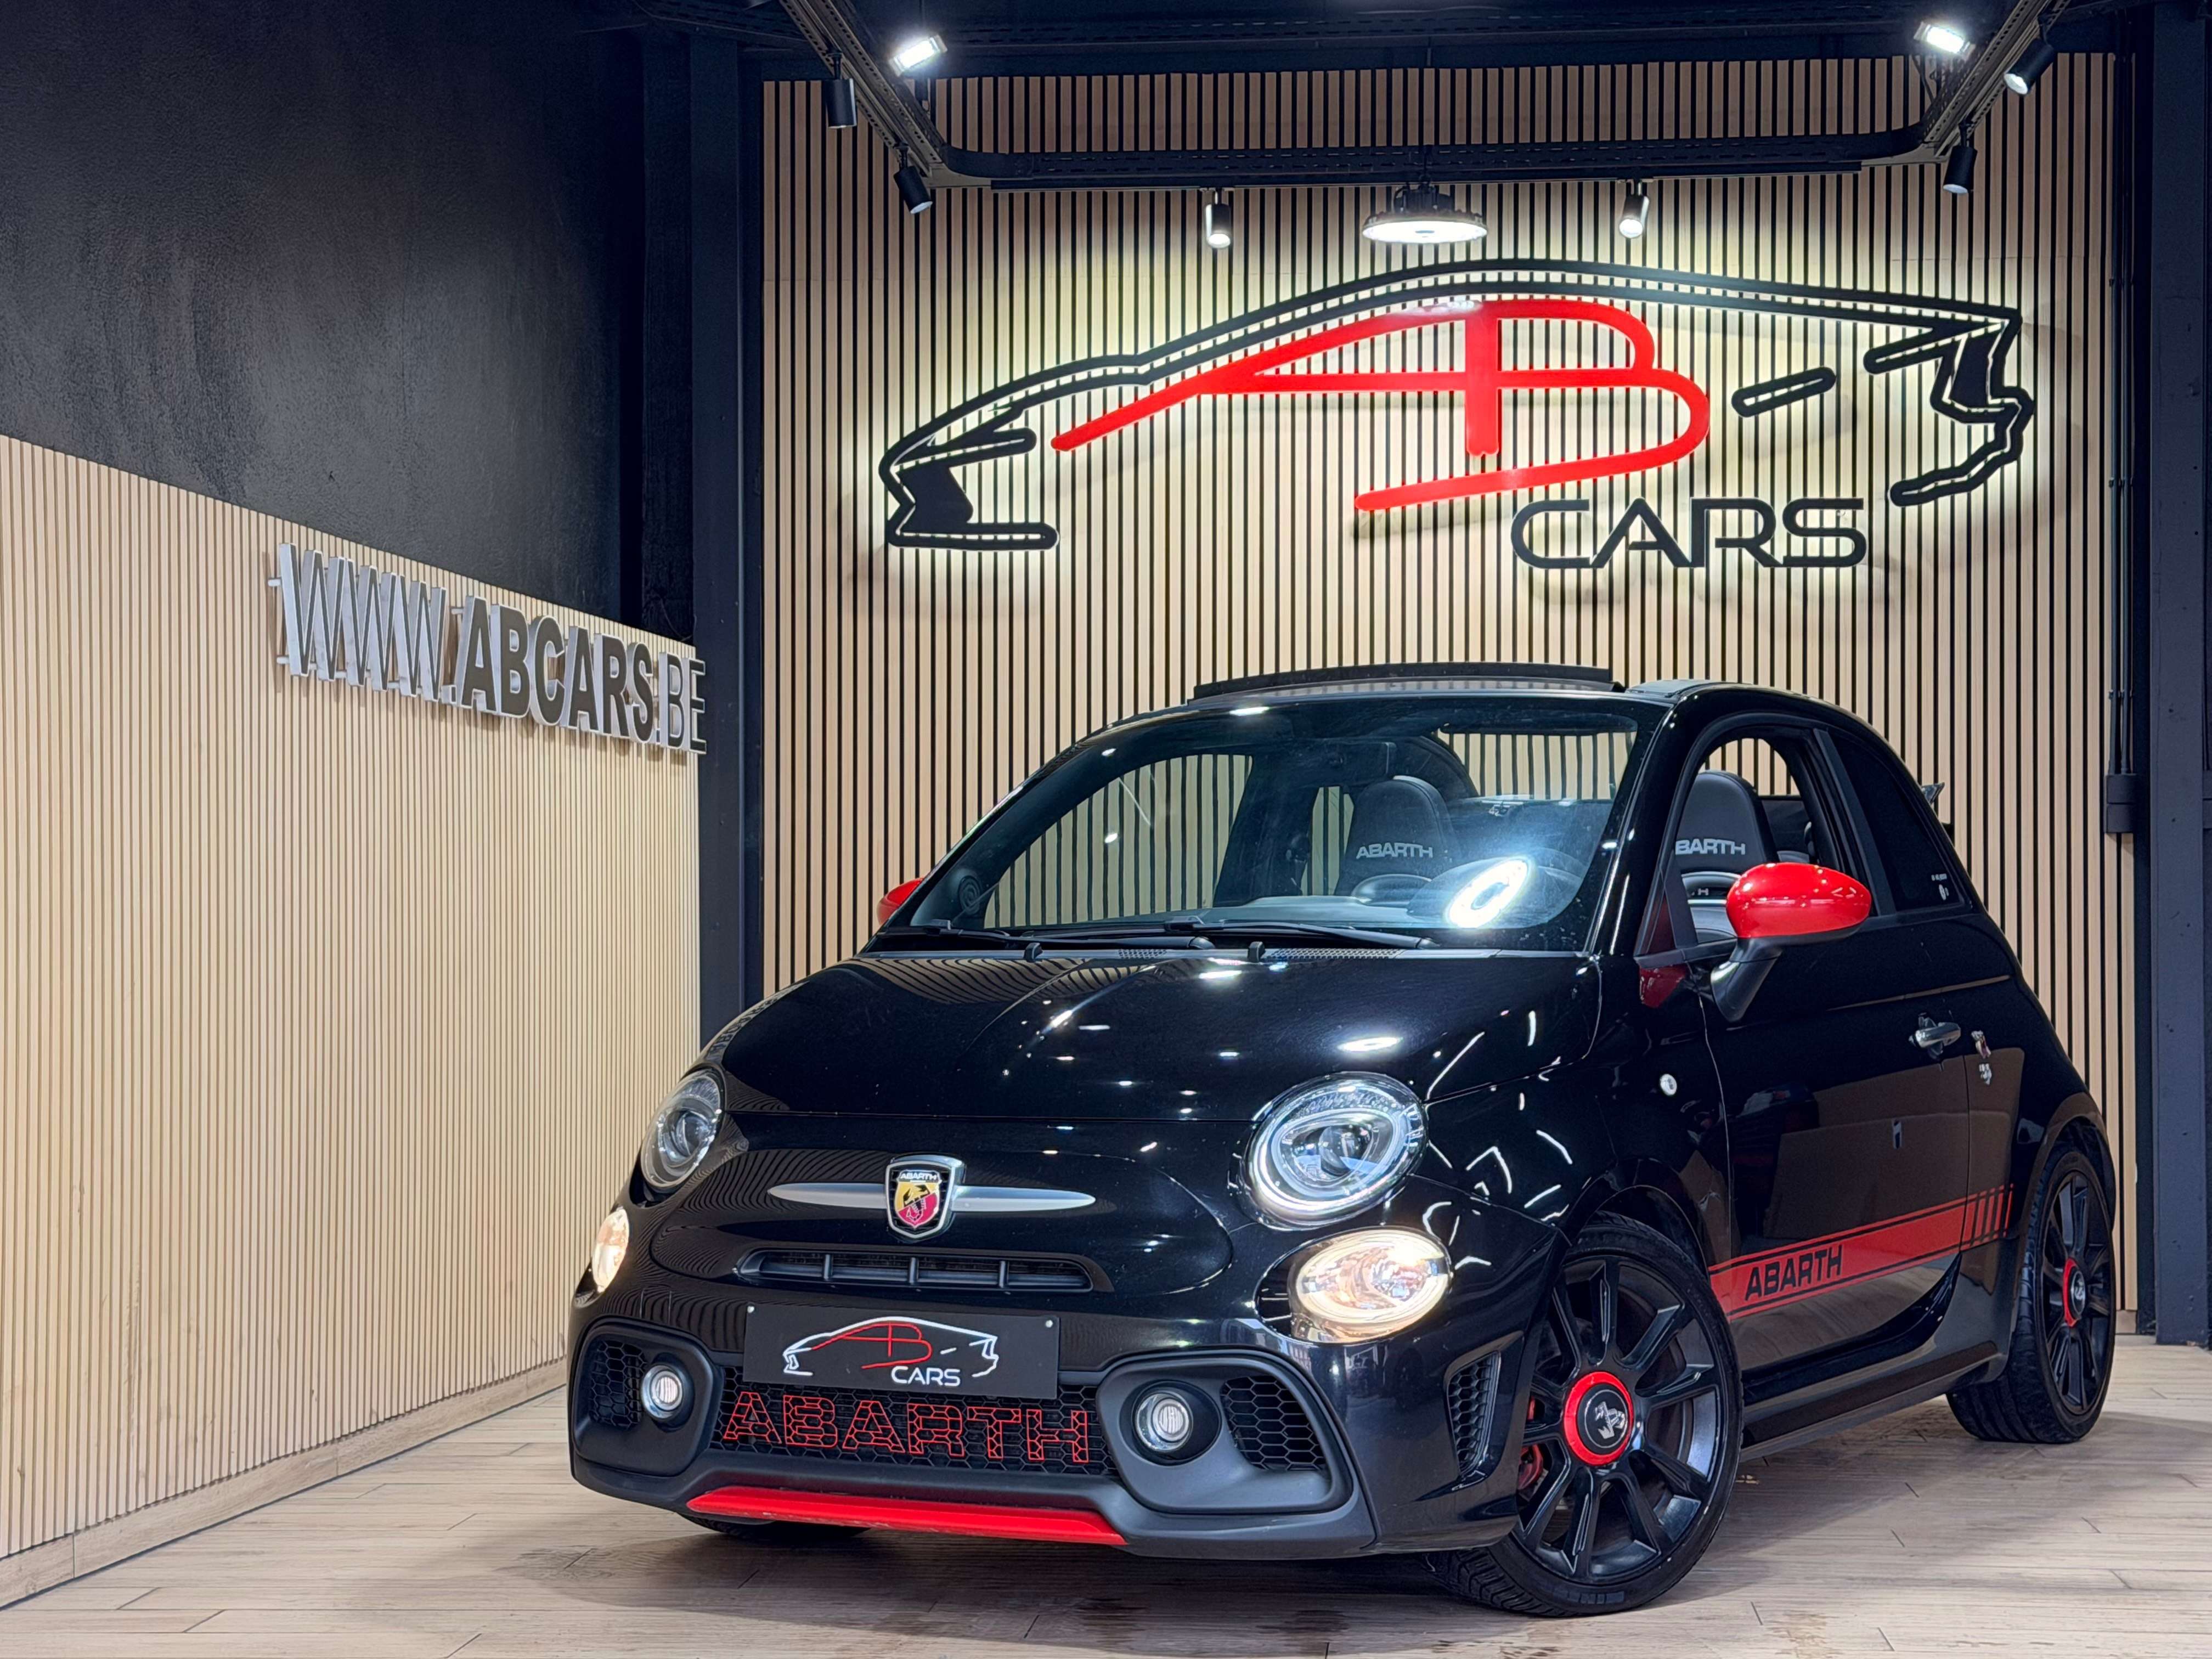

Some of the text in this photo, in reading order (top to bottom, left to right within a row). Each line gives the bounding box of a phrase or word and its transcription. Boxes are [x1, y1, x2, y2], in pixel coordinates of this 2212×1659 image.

[1511, 496, 1867, 568] CARS
[279, 543, 707, 754] WWW.ABCARS.BE
[1356, 842, 1433, 859] ABARTH
[1675, 838, 1746, 855] BARTH
[1745, 1244, 1843, 1301] ABARTH
[891, 1365, 961, 1387] CARS
[723, 1391, 1089, 1463] ABARTH
